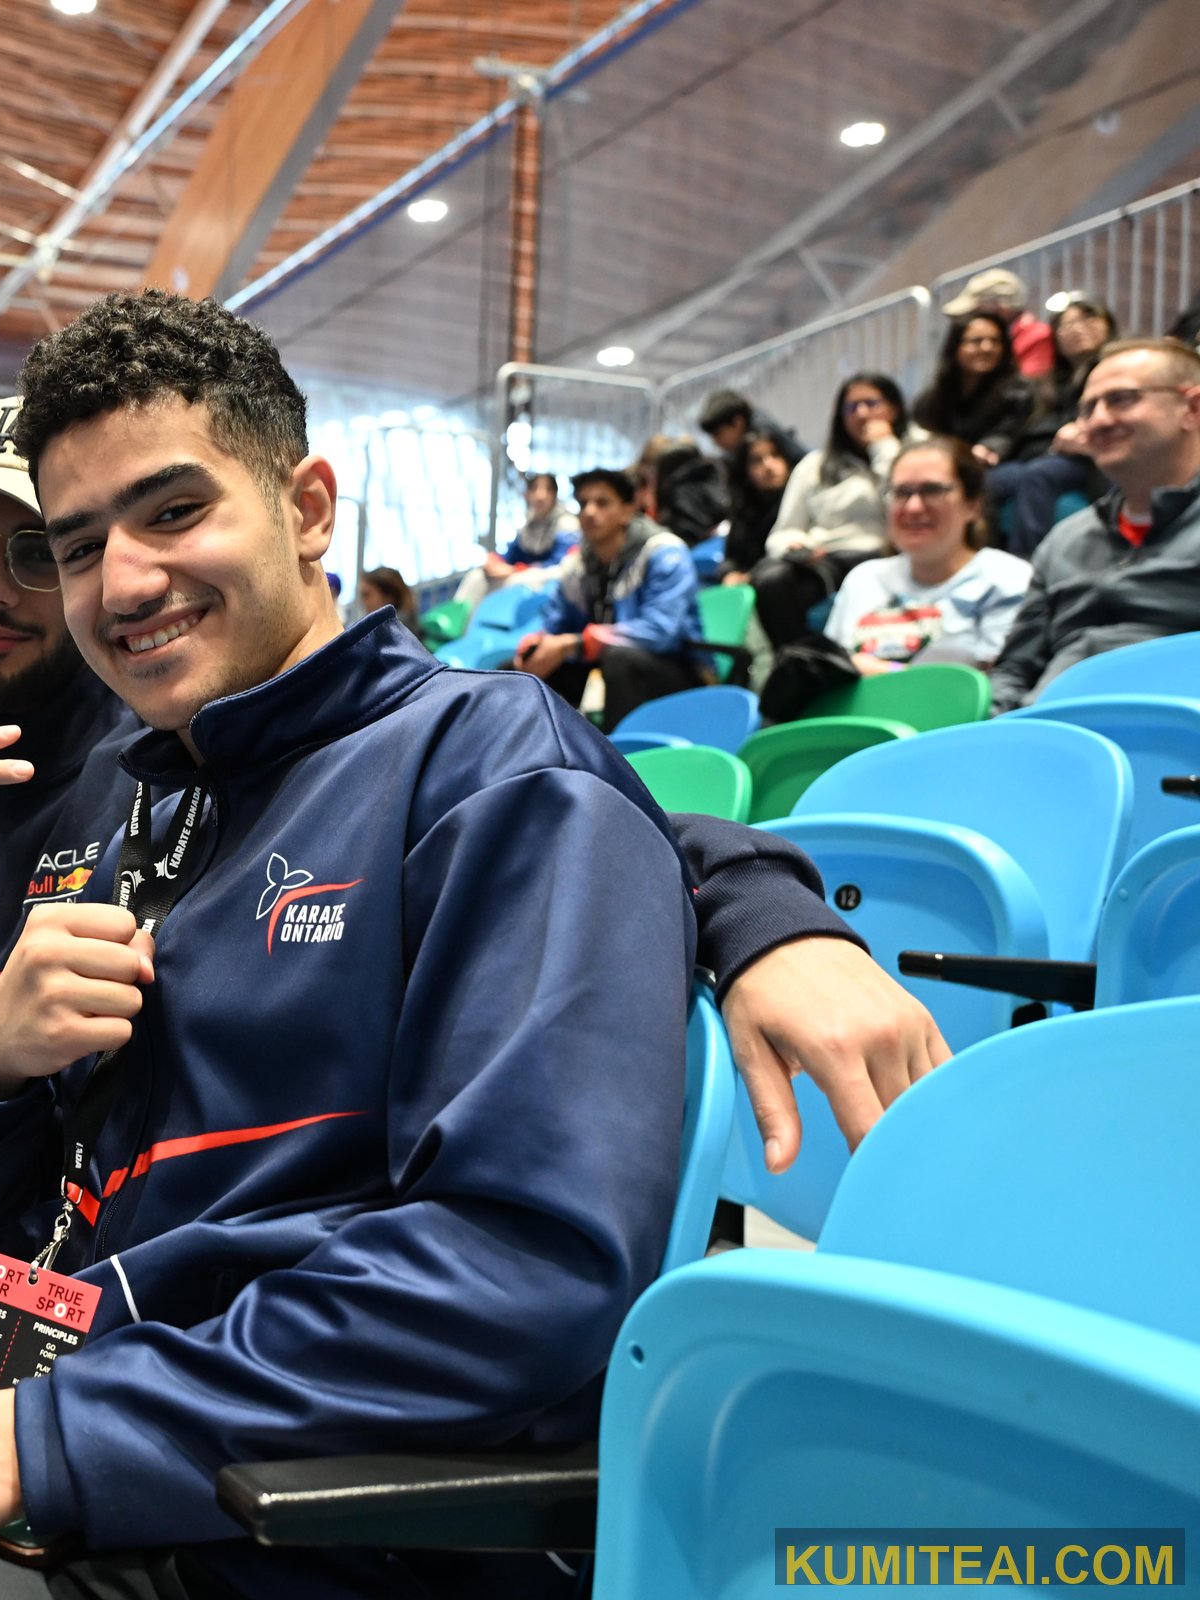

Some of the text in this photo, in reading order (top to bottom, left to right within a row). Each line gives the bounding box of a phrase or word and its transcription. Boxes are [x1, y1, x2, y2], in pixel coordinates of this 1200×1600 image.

[130, 798, 142, 837] CANADA
[169, 785, 202, 869] KARATE CANADA
[35, 841, 100, 873] ACLE
[119, 880, 131, 910] KARA
[284, 903, 346, 924] KARATE
[280, 921, 345, 943] ONTARIO
[48, 1282, 84, 1306] TRUE
[36, 1296, 86, 1323] SPORT
[32, 1321, 79, 1346] PRINCIPLES
[45, 1342, 57, 1352] GO
[36, 1362, 52, 1374] PLAY
